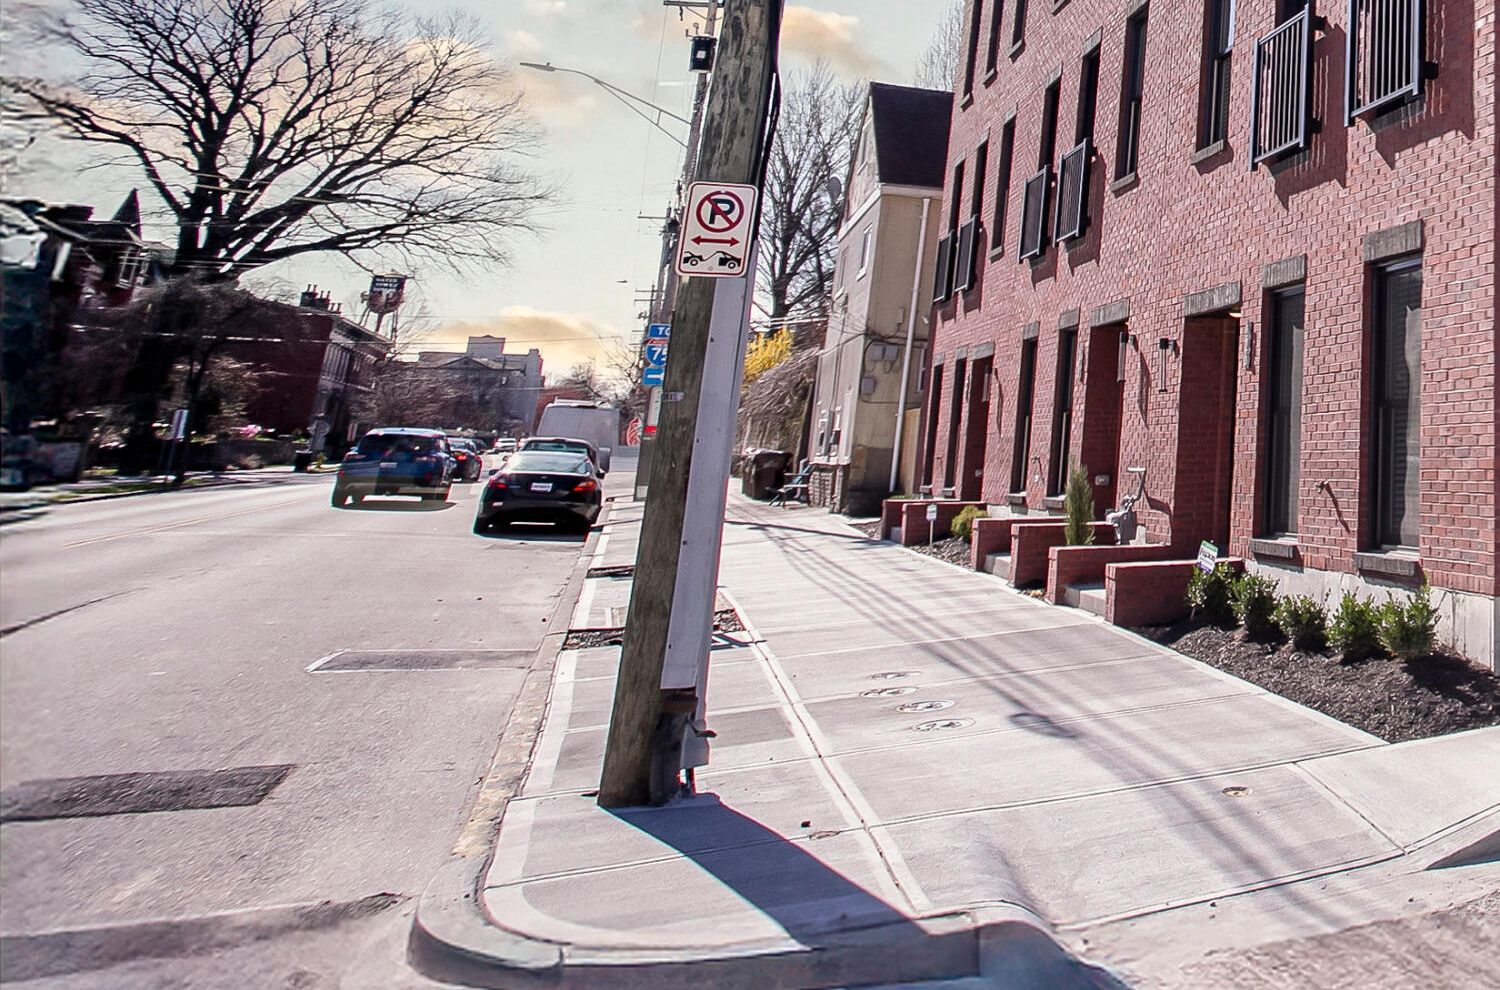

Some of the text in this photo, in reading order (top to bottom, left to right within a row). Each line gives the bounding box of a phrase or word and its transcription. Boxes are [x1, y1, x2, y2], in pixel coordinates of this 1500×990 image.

[708, 198, 736, 225] P
[657, 326, 671, 336] TO
[651, 347, 668, 361] 75
